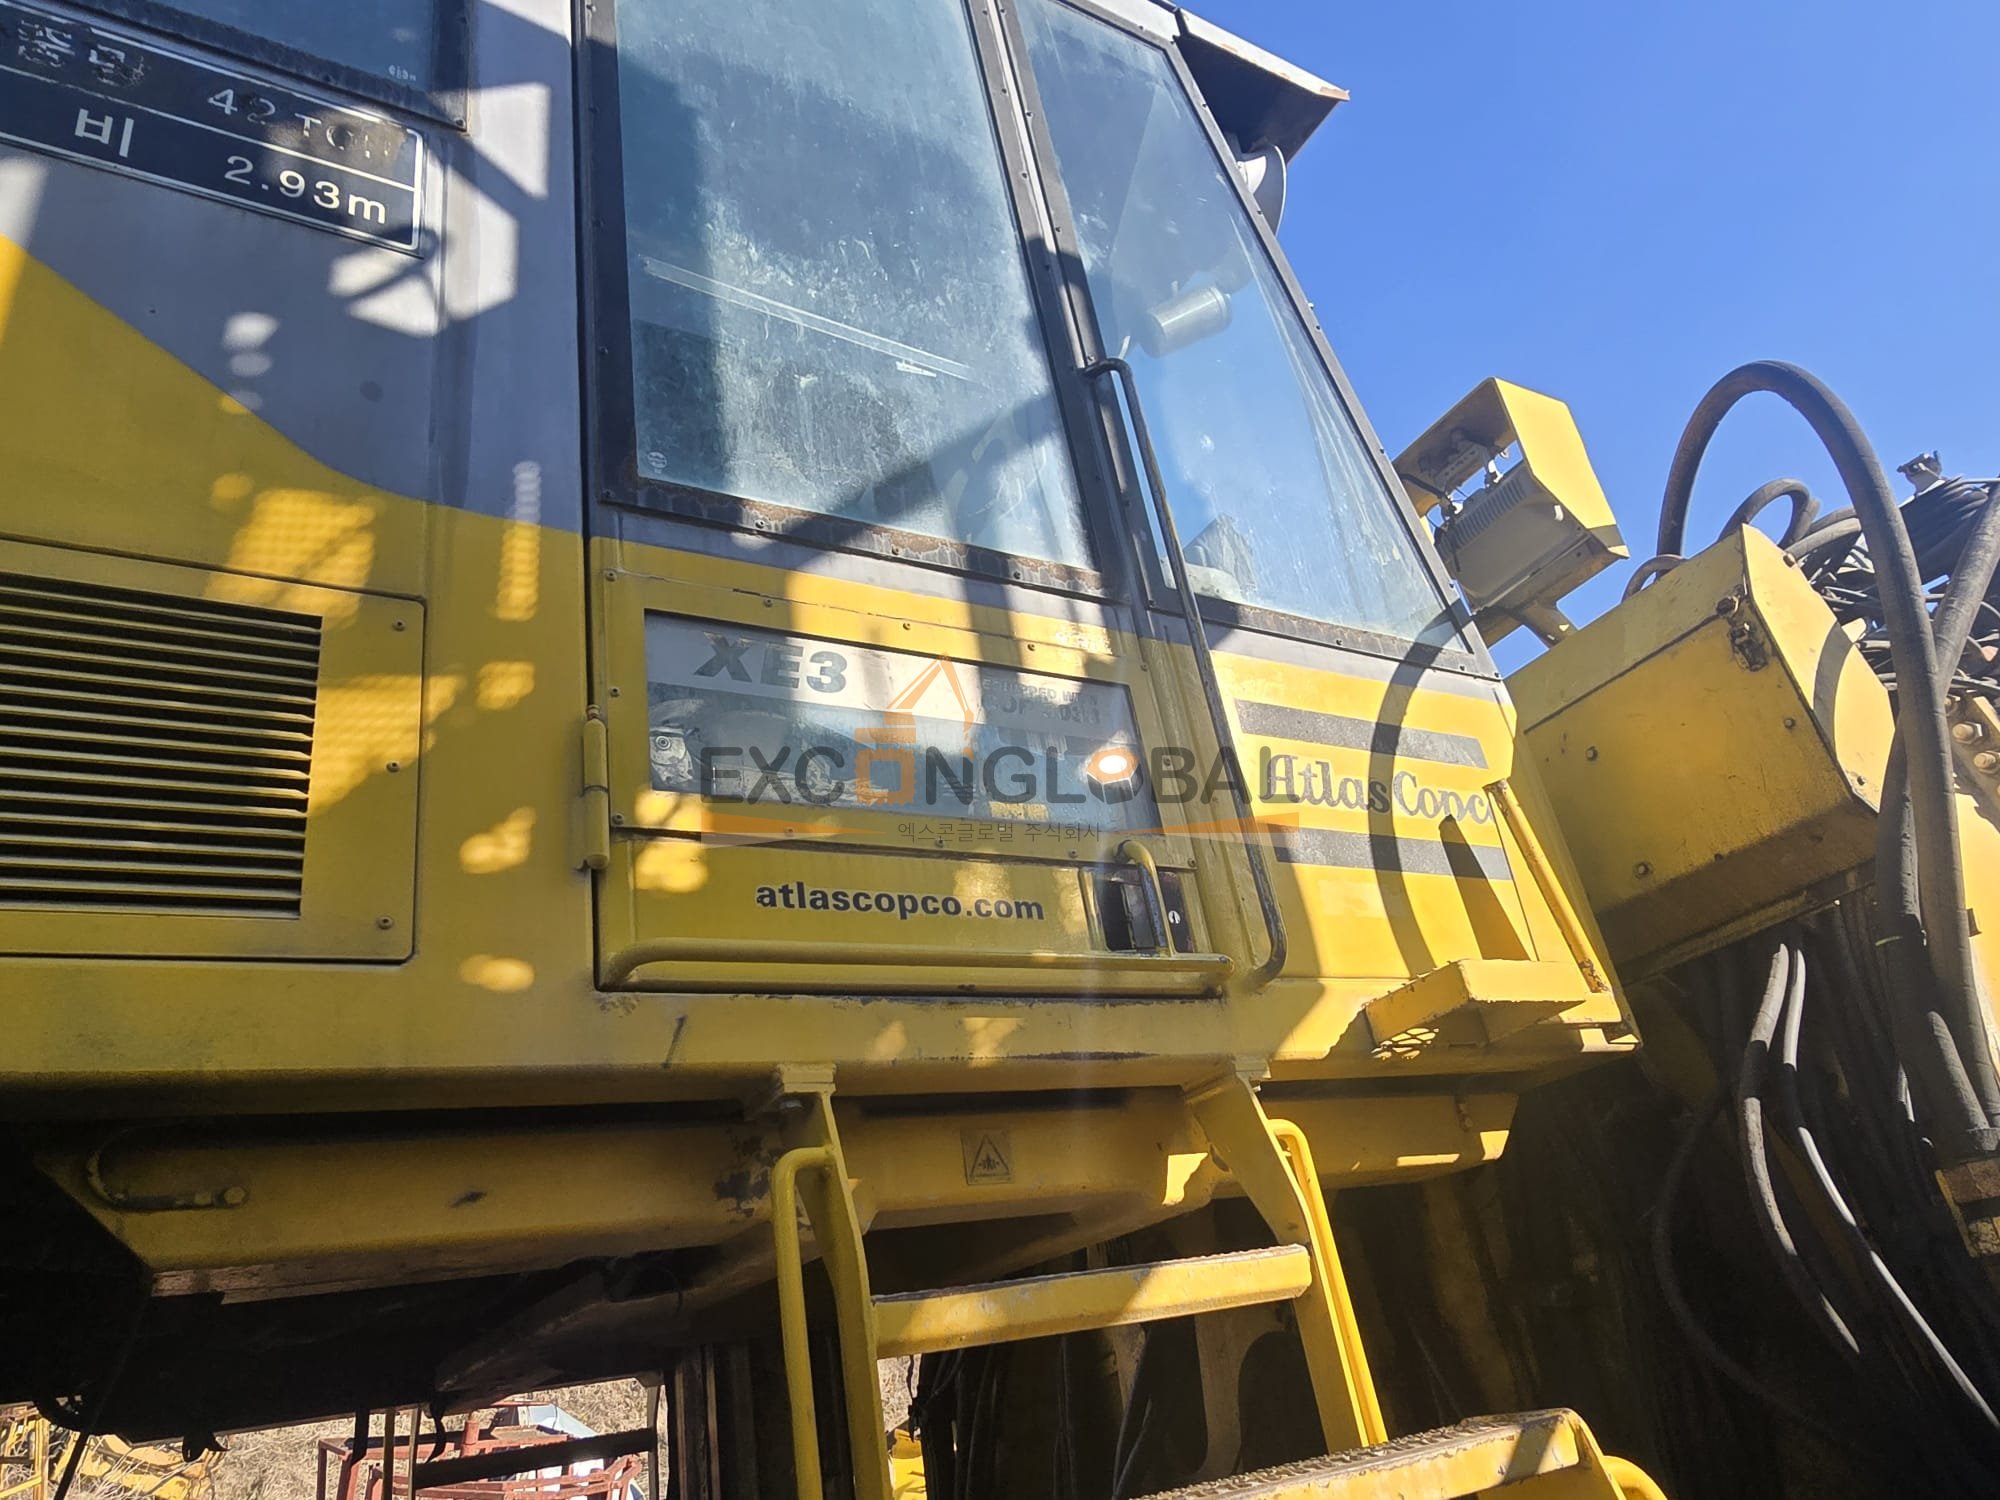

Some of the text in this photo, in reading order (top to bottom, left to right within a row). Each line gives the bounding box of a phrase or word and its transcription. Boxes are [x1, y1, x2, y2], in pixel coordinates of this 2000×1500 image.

[224, 155, 387, 225] 2.93m
[694, 631, 849, 694] XE3
[1260, 754, 1391, 814] Atlas
[755, 881, 1045, 921] atlascopco.com
